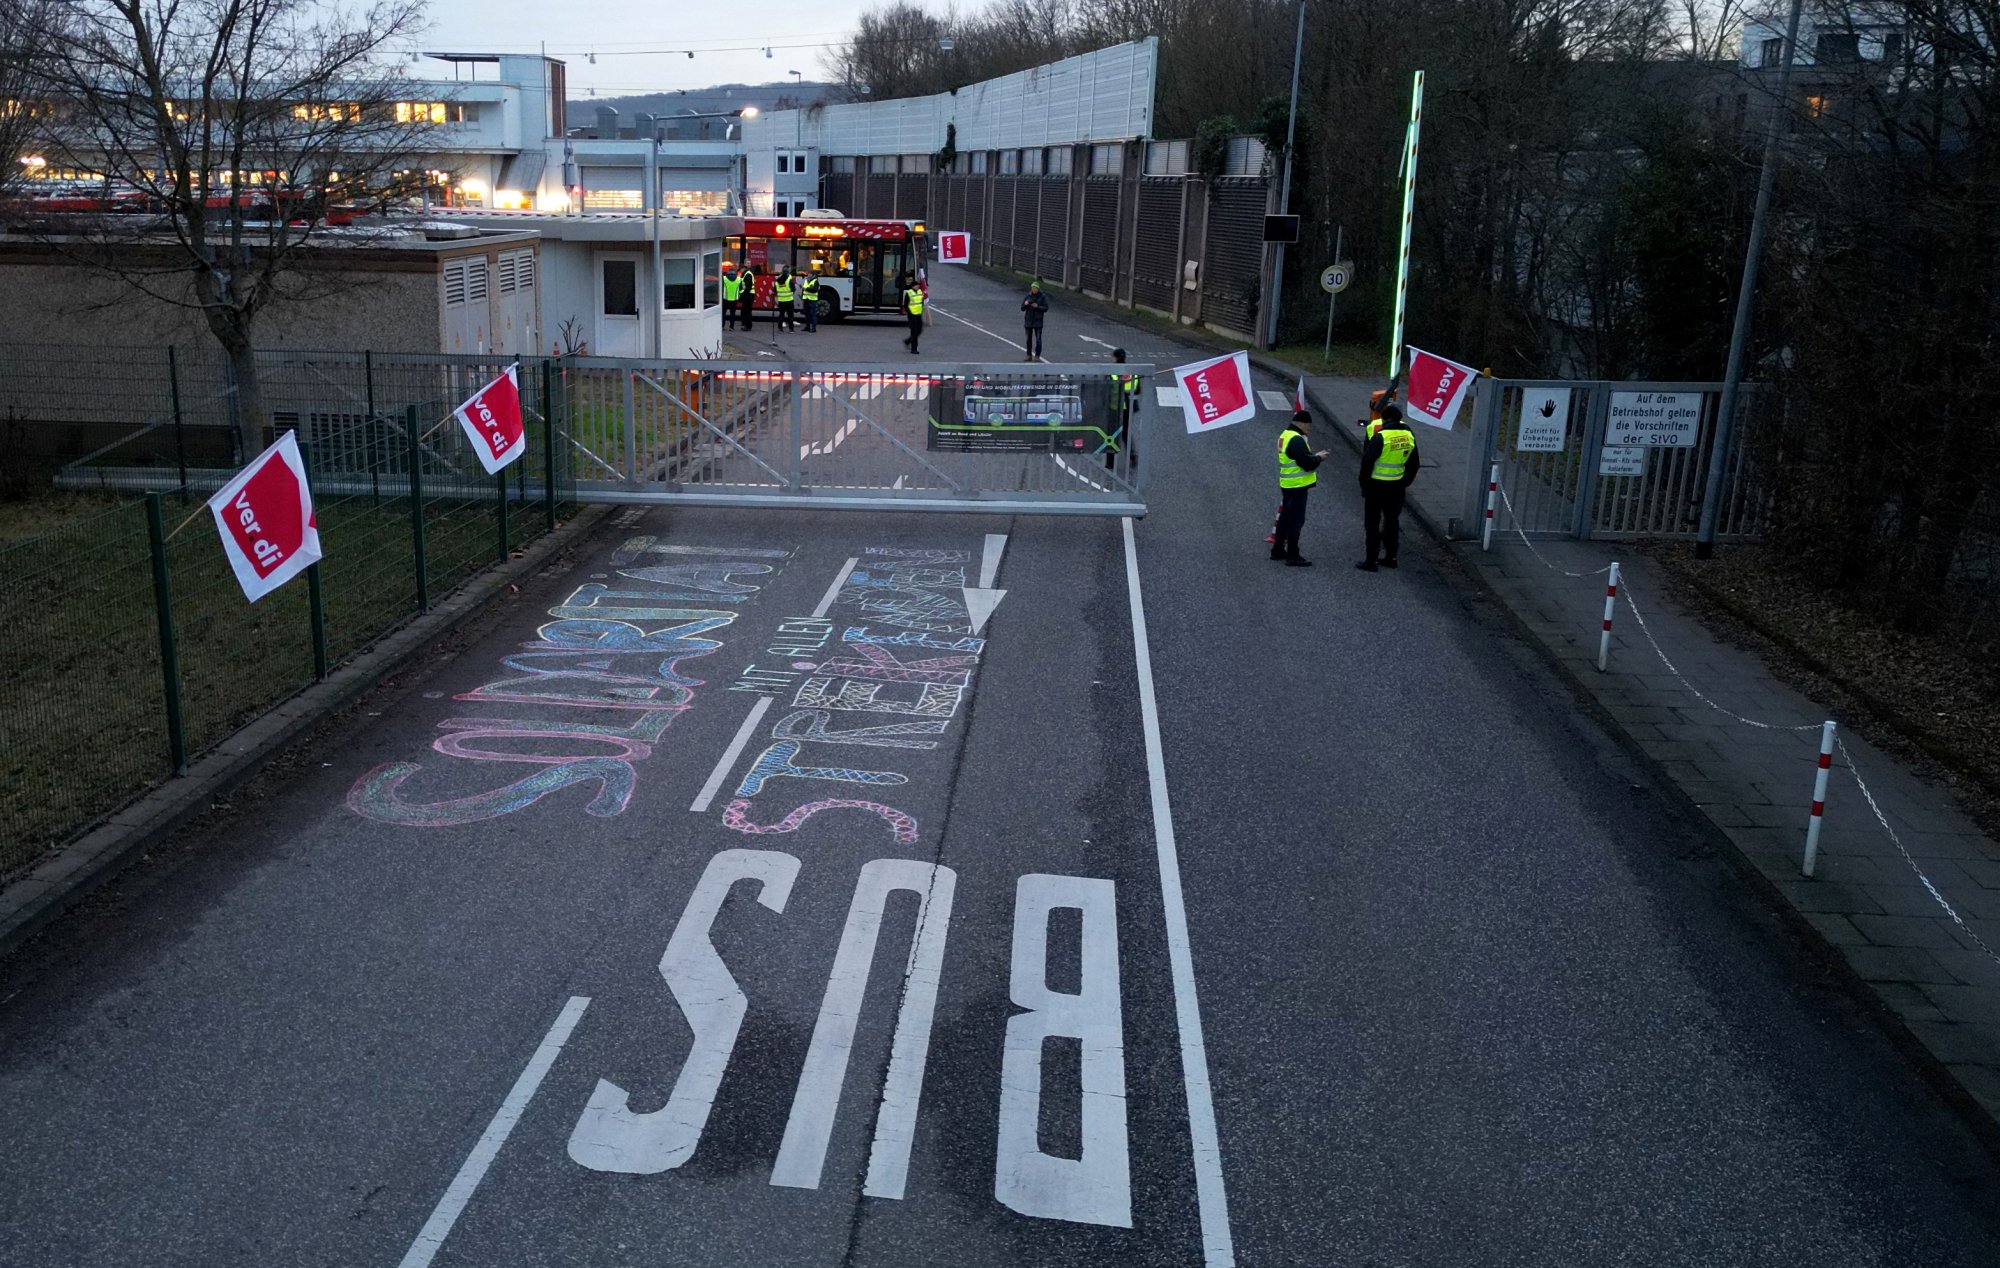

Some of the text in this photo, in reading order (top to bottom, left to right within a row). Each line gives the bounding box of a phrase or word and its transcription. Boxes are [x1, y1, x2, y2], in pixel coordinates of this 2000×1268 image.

[1327, 273, 1343, 285] 30
[1196, 372, 1219, 419] ver.di
[1636, 394, 1676, 404] Auf dem
[475, 397, 508, 452] ver.di
[1612, 407, 1697, 419] Betriebshof gelten
[1616, 421, 1689, 431] die Vorschriften
[1623, 434, 1678, 444] der StVO
[235, 490, 284, 568] ver.di
[728, 616, 834, 694] MIT ALLEN
[567, 848, 1133, 1229] BUS
